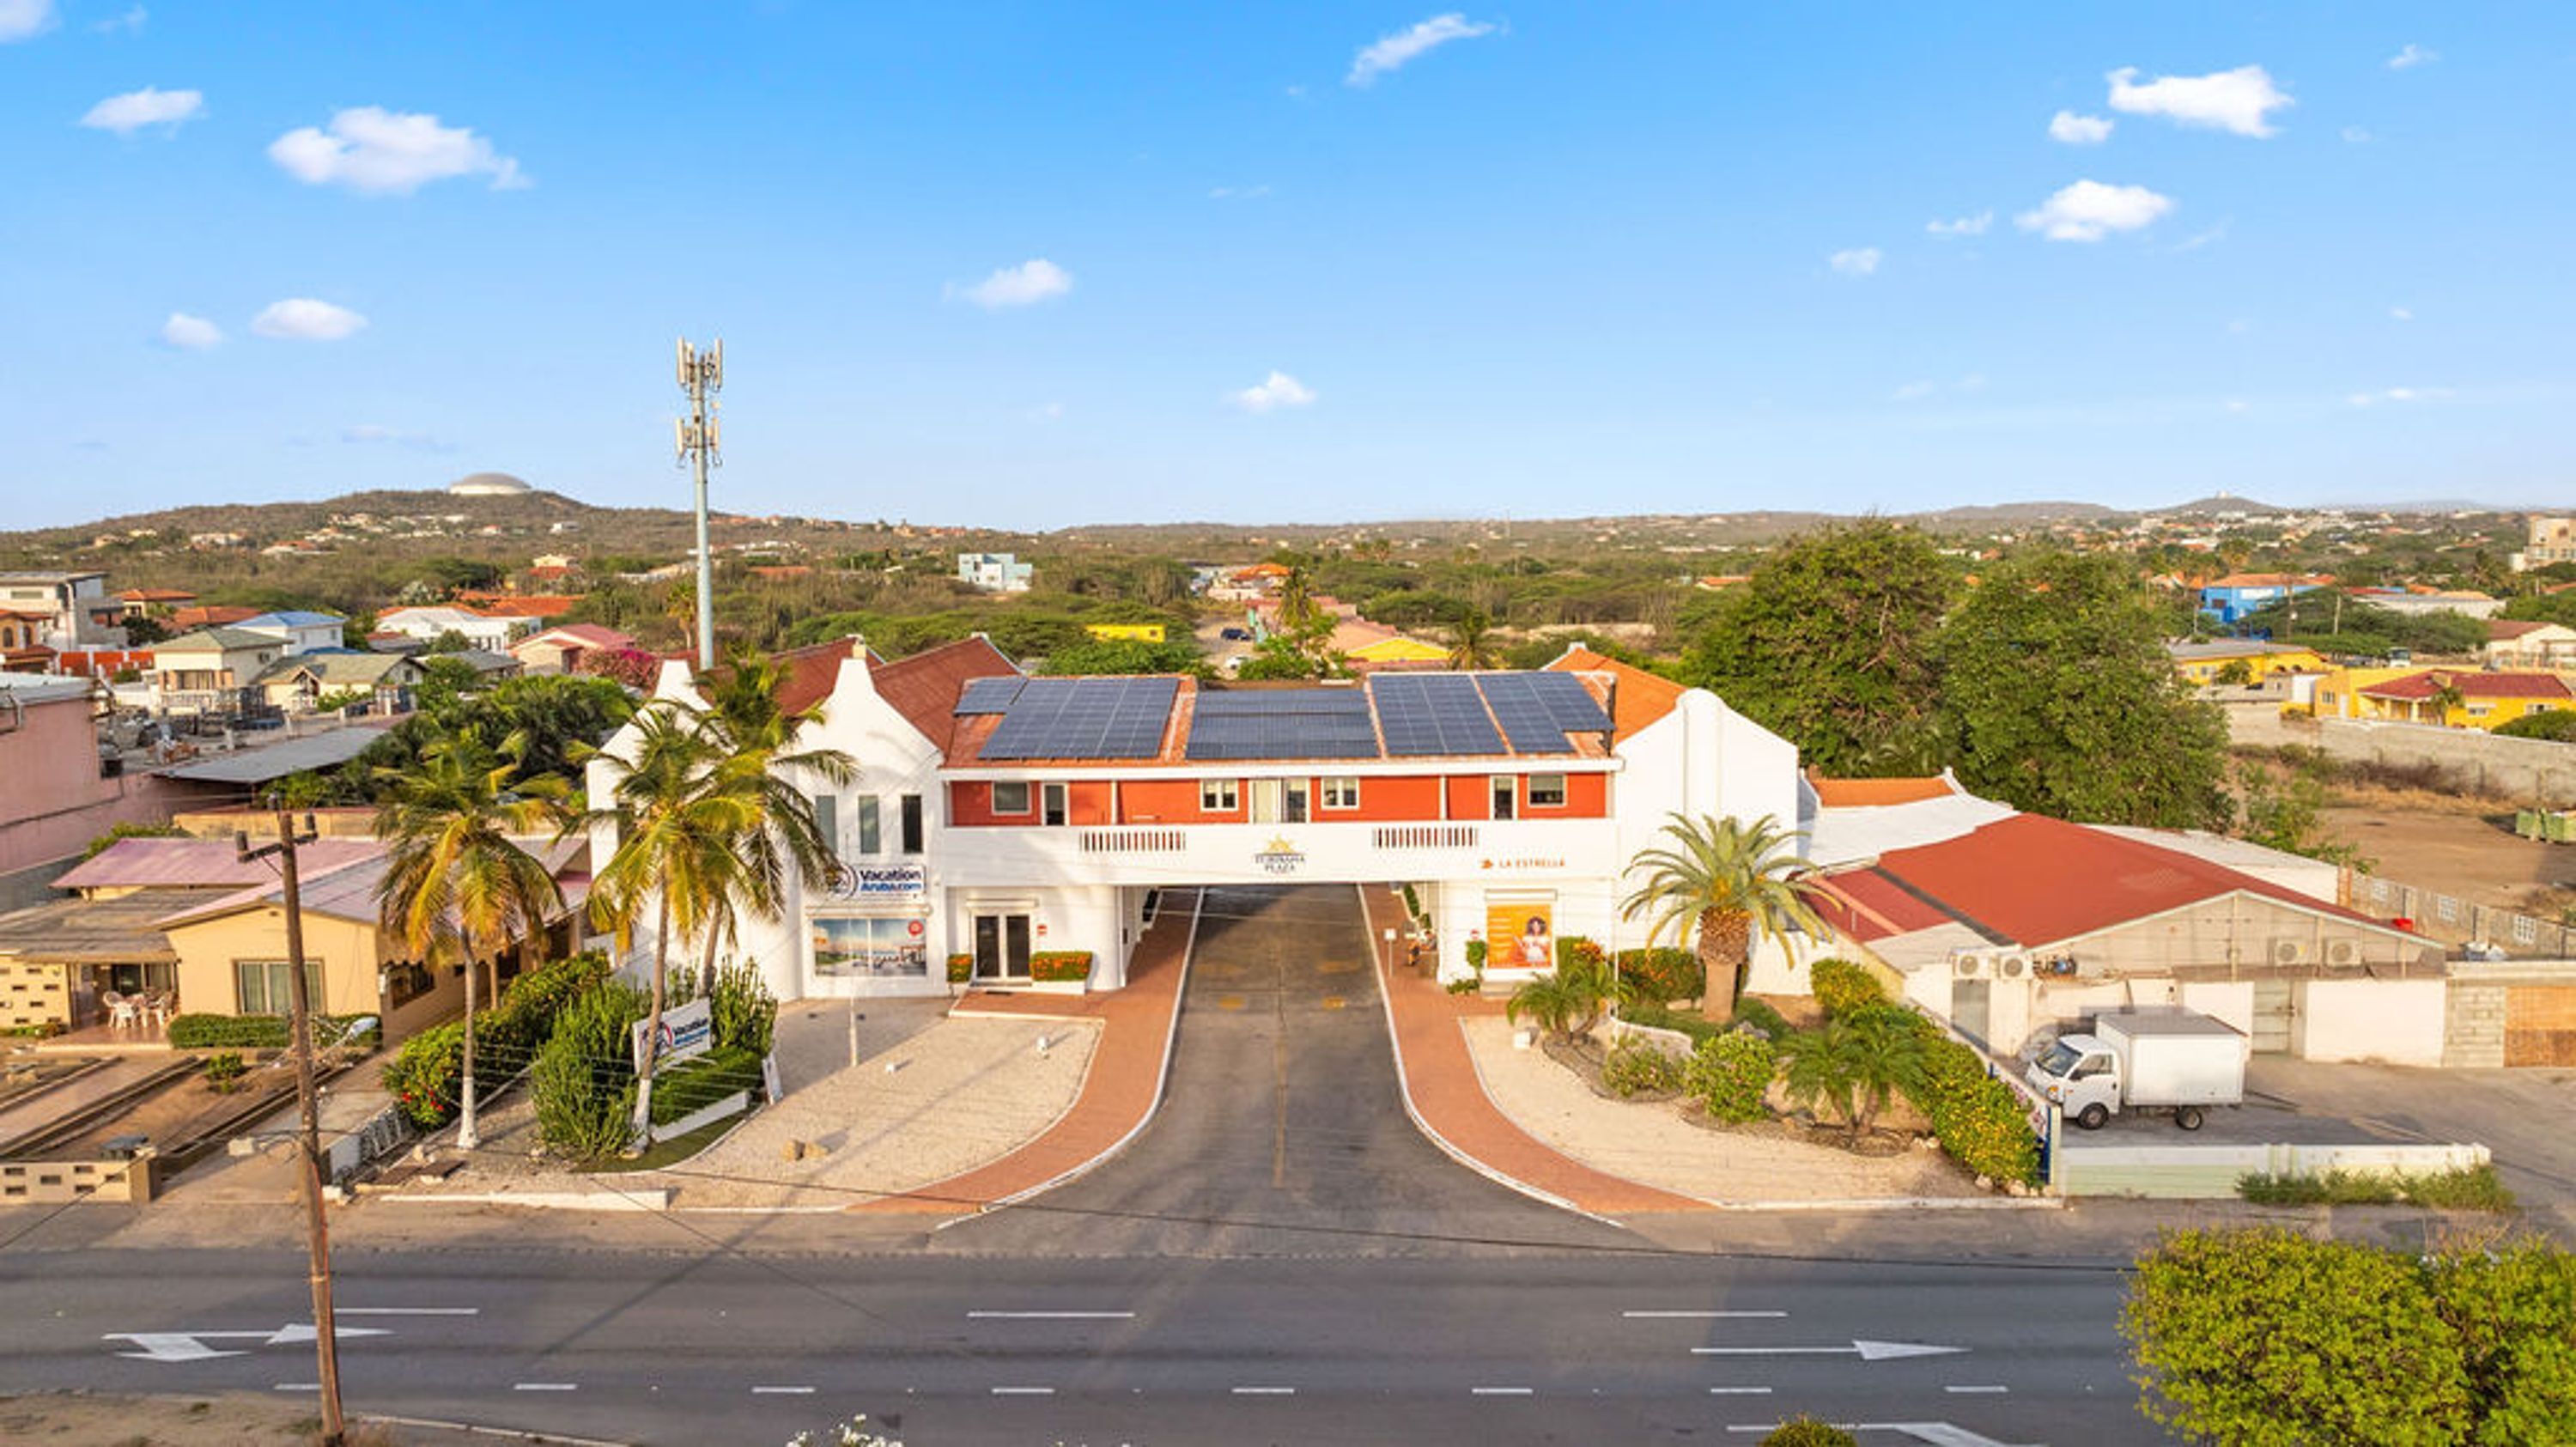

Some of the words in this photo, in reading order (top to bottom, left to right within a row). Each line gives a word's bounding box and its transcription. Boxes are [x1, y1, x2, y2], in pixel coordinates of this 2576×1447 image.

[1498, 858, 1511, 868] LA
[1516, 858, 1565, 867] ESTRELLA
[860, 868, 921, 881] Vacation
